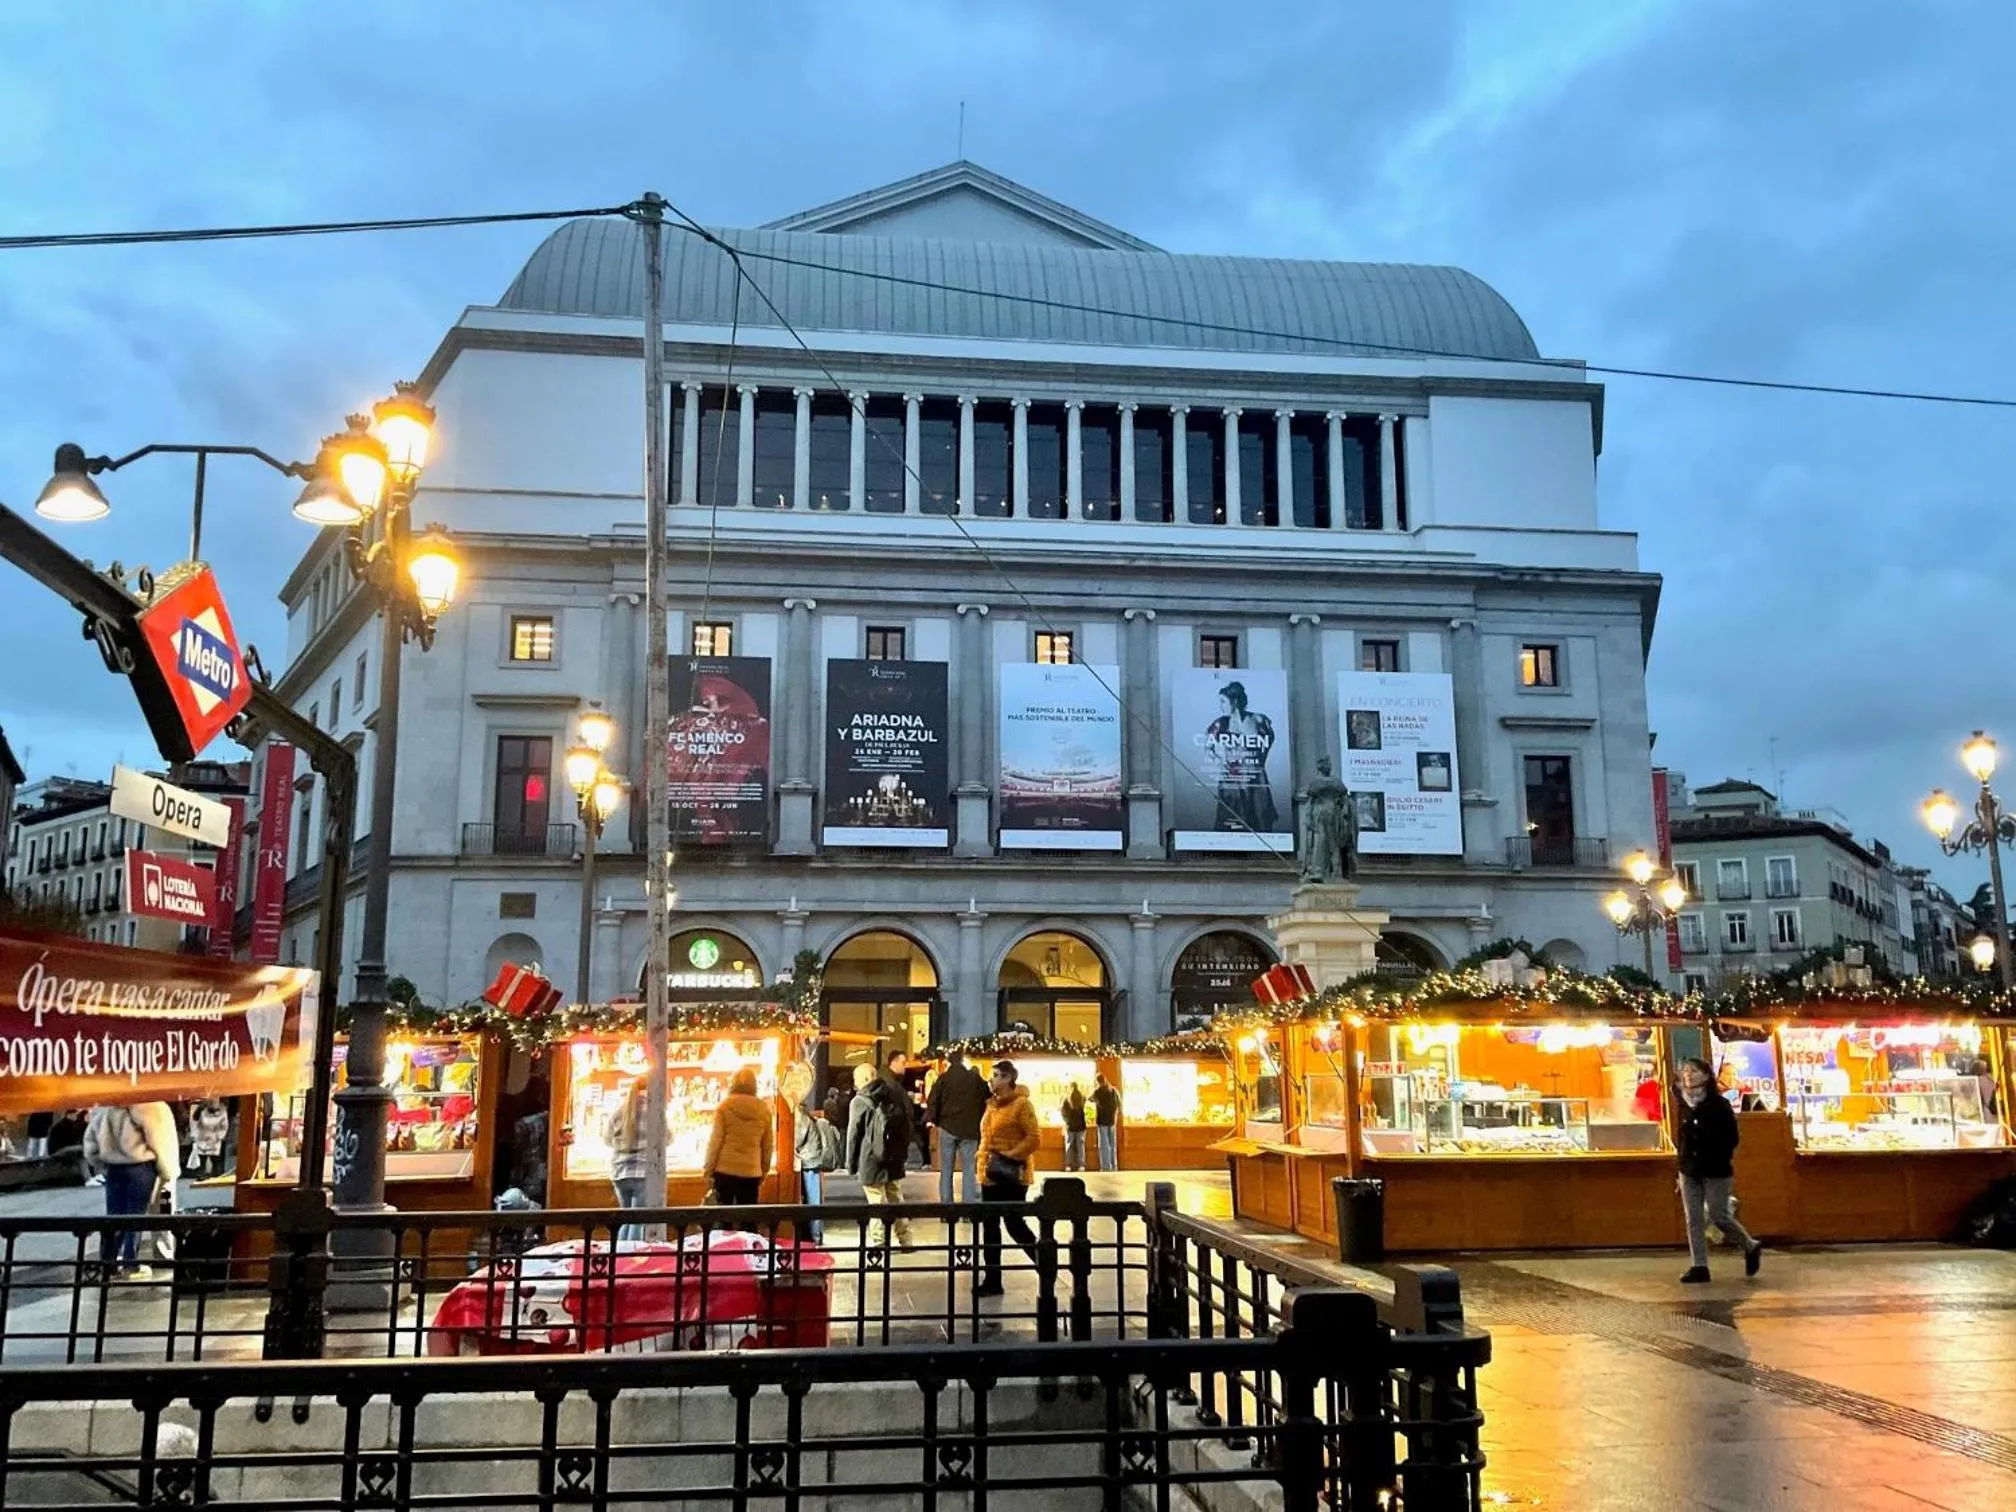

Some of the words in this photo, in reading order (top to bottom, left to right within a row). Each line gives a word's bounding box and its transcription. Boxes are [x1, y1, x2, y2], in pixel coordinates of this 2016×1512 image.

[185, 628, 231, 689] Metro
[1350, 696, 1367, 706] EN
[1370, 697, 1441, 707] CONCIERTO
[1025, 714, 1069, 722] SOSTENIBLE
[1087, 715, 1115, 723] MUNDO
[1026, 706, 1055, 714] PREMIO
[1067, 707, 1096, 715] TEATRO
[851, 713, 925, 728] ARIADNA
[668, 731, 745, 744] FLAMENCO
[837, 728, 848, 740] Y
[852, 728, 938, 743] BARBAZUL
[1192, 733, 1270, 749] CARMEN
[688, 744, 725, 755] REAL
[276, 774, 288, 799] REAL
[152, 784, 202, 830] Opera
[274, 800, 285, 838] TEATRO
[163, 875, 197, 898] LOTERÍA
[164, 894, 206, 917] NACIONAL
[667, 973, 754, 988] TARBUCKS
[17, 951, 104, 1028] Ópera
[110, 983, 152, 1017] vas
[150, 986, 167, 1016] a
[166, 986, 231, 1022] cantar
[0, 1033, 70, 1078] como
[74, 1030, 98, 1076] te
[103, 1031, 165, 1087] toque
[167, 1029, 185, 1073] El
[188, 1030, 239, 1073] Gordo
